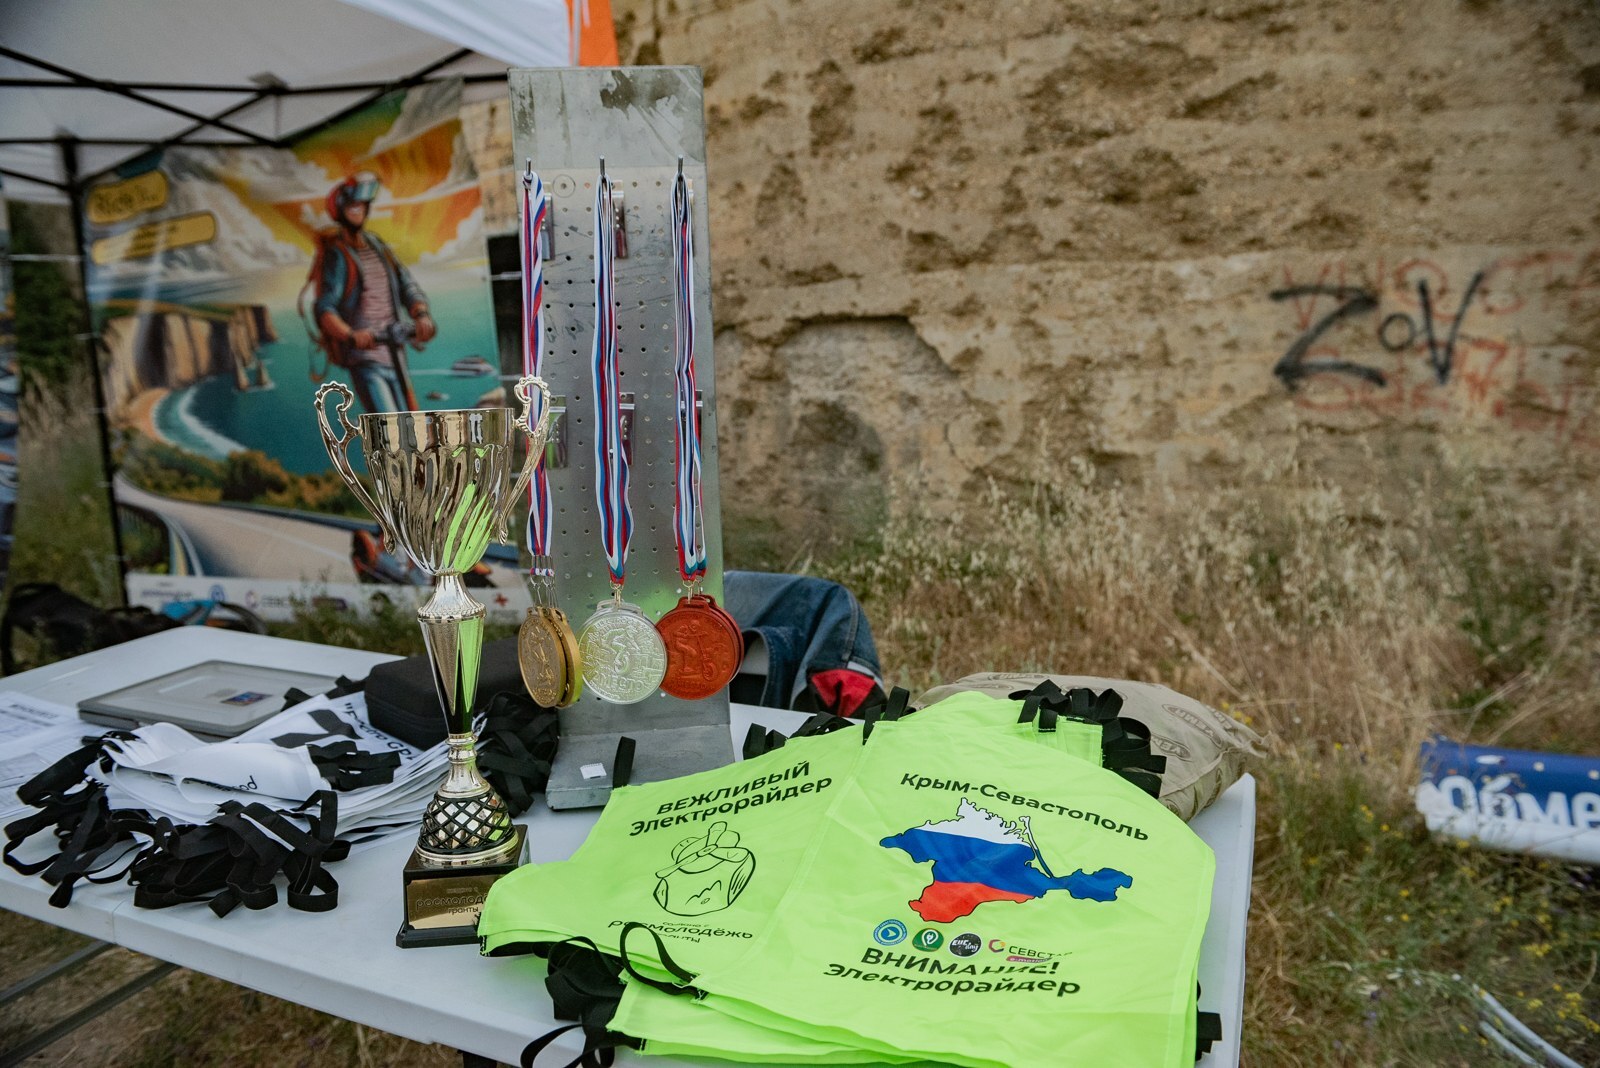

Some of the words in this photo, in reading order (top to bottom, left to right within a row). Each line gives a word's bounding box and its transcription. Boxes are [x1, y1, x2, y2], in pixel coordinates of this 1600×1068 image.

[629, 777, 833, 838] Электрорайдер
[656, 760, 811, 816] ВЕЖЛИВЫЙ
[900, 772, 1150, 842] Крым-Севастополь
[448, 906, 479, 916] гранты
[608, 920, 754, 939] рмолодёжь
[824, 963, 1081, 996] Электрорайдер
